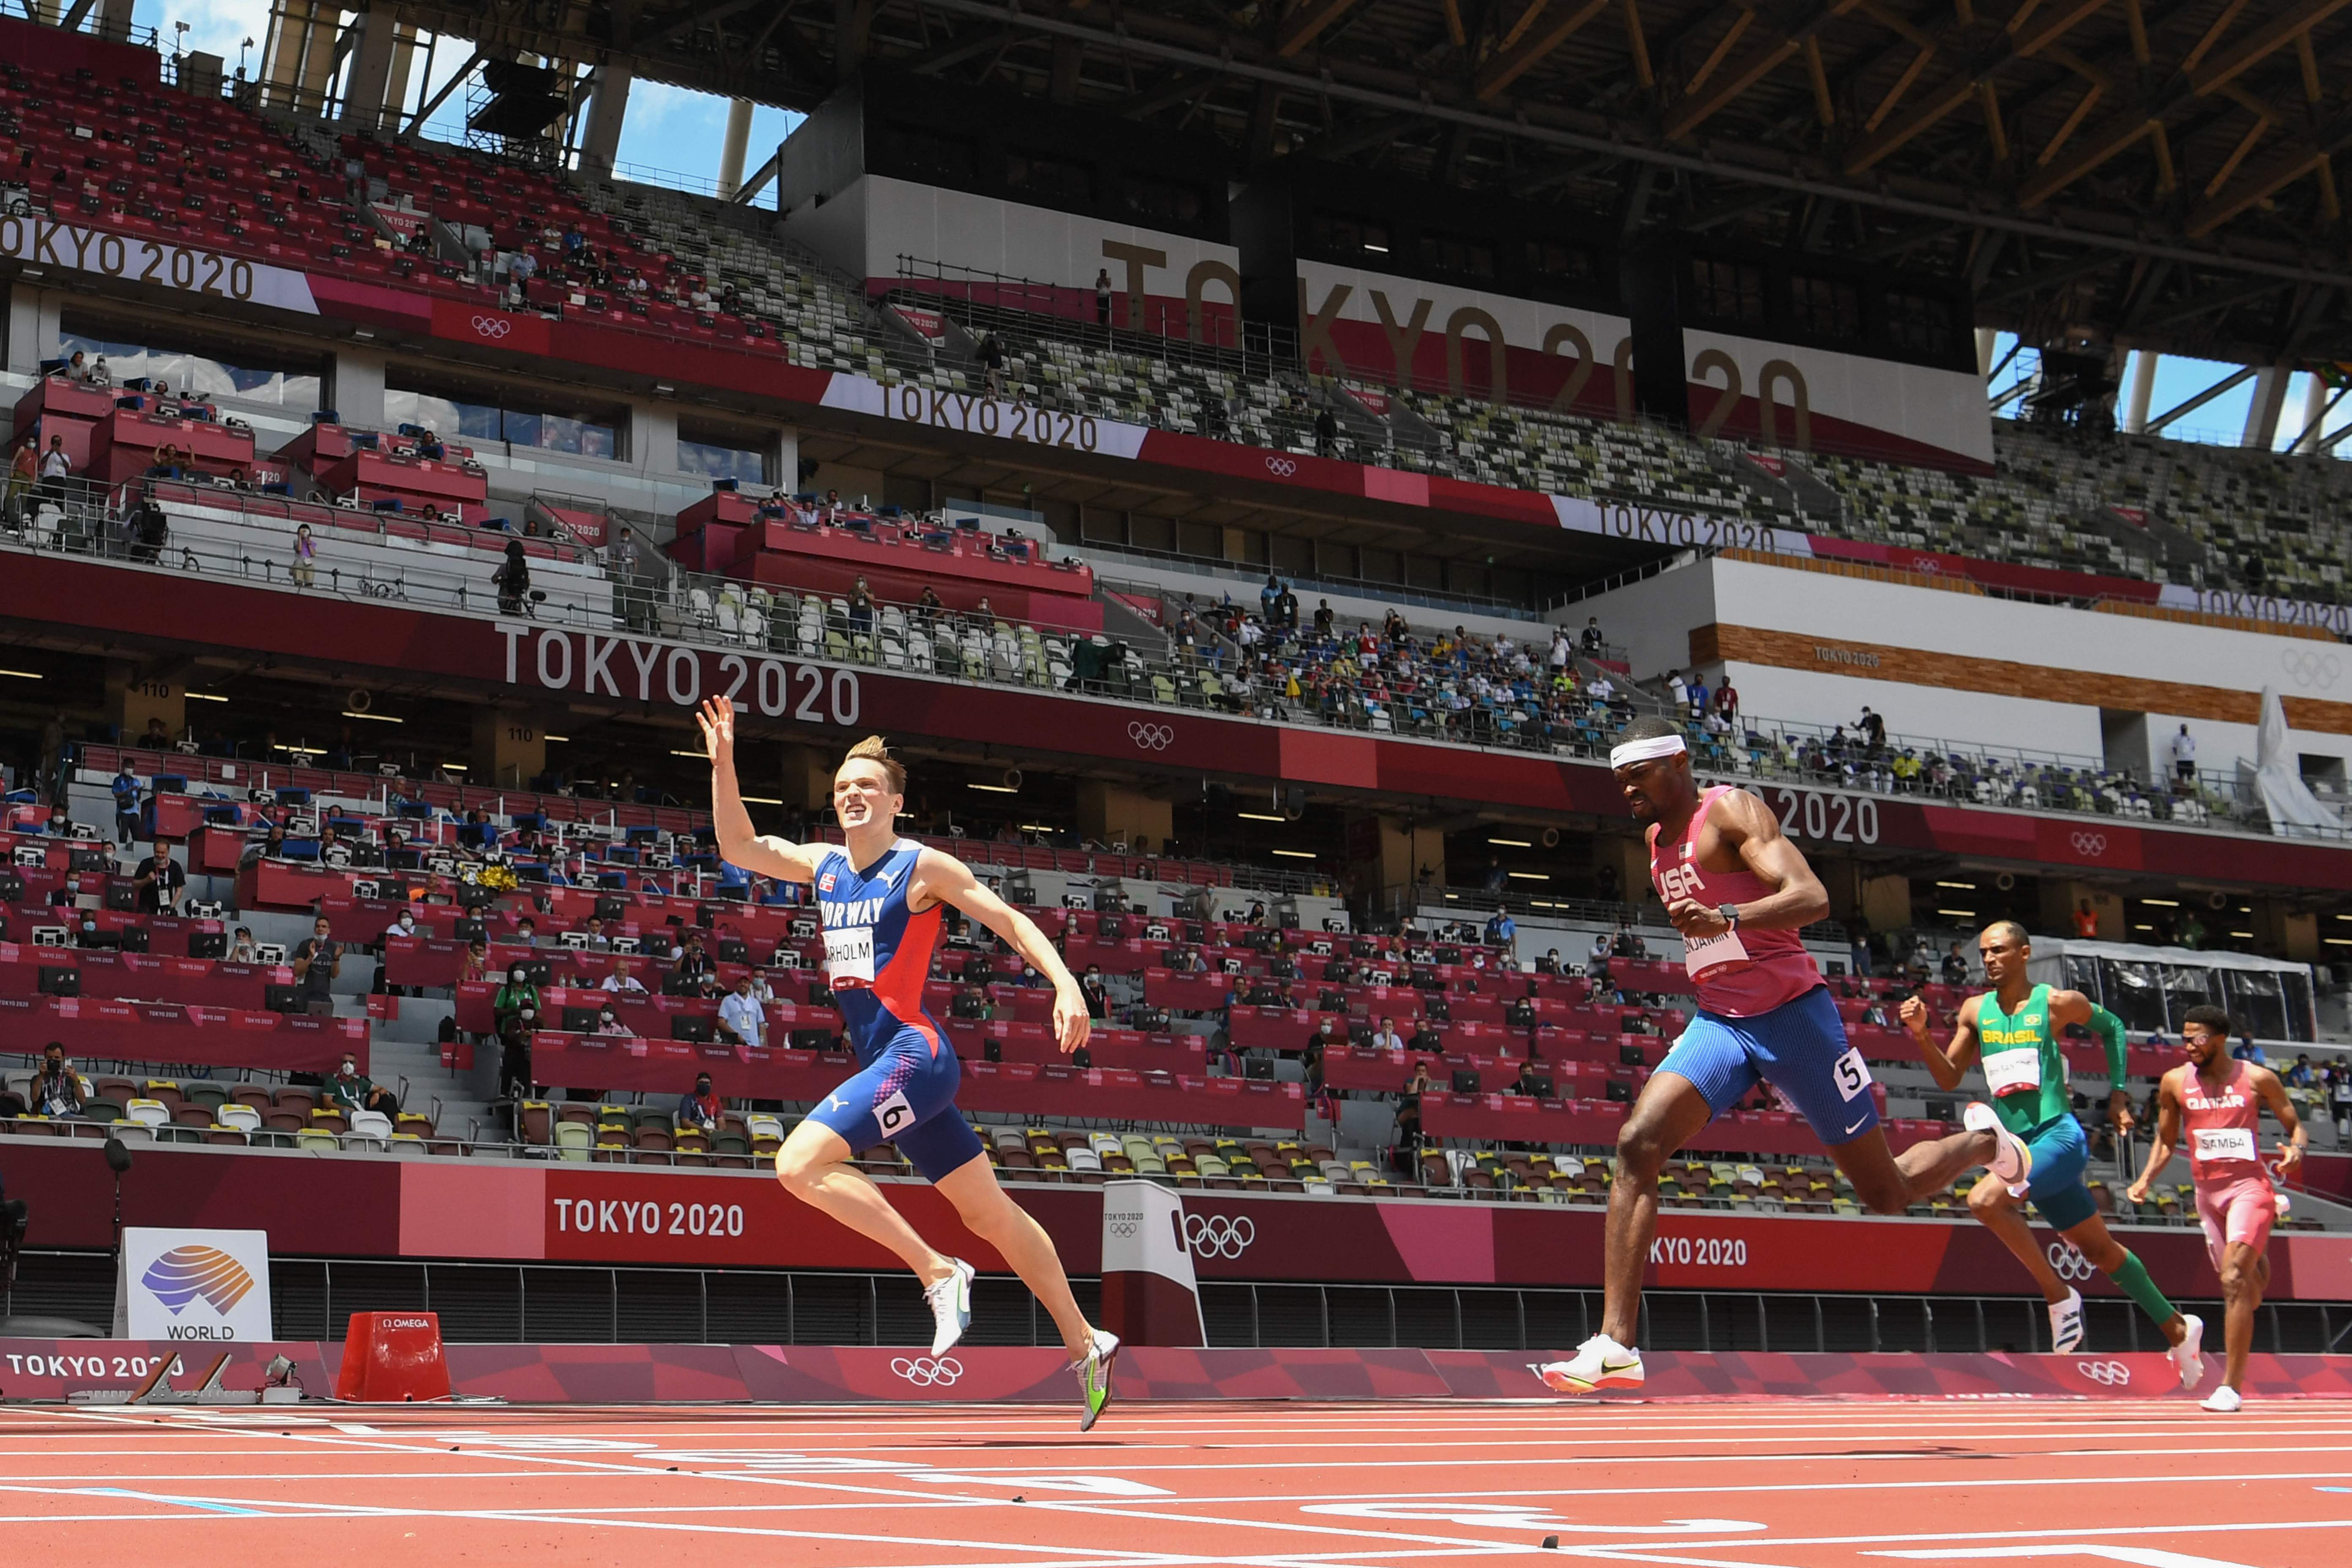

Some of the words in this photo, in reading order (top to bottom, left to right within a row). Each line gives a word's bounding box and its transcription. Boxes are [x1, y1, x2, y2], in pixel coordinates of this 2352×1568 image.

[405, 218, 425, 229] 20
[140, 242, 253, 301] 2020
[877, 381, 999, 436] TOKYO
[1011, 408, 1097, 452] 2020
[577, 524, 600, 536] 2020
[1594, 501, 1695, 547] TOKYO
[1704, 518, 1774, 553] 2020
[2197, 592, 2278, 621] TOKYO
[2287, 602, 2349, 633] 2020
[1815, 646, 1851, 664] TOKYO
[1853, 652, 1879, 667] 2020
[495, 622, 700, 705] TOKYO
[719, 655, 859, 726] 2020
[142, 683, 169, 698] 110
[508, 727, 533, 742] 110
[1778, 790, 1878, 844] 2020
[1653, 863, 1706, 903] USA
[821, 897, 885, 928] NORWAY
[1982, 1029, 2042, 1044] BRASIL
[1839, 1057, 1861, 1091] 5
[2186, 1095, 2246, 1110] QATAR
[883, 1105, 907, 1129] 6
[2201, 1137, 2245, 1149] SAMBA
[554, 1198, 660, 1234] TOKYO
[669, 1203, 744, 1236] 2020
[1103, 1213, 1125, 1221] TOKYO
[1127, 1213, 1144, 1221] 2020
[1644, 1237, 1691, 1265] KYO
[1696, 1238, 1747, 1266] 2020
[167, 1325, 234, 1340] WORLD
[394, 1319, 429, 1328] OMEGA
[7, 1354, 106, 1377] TOKYO
